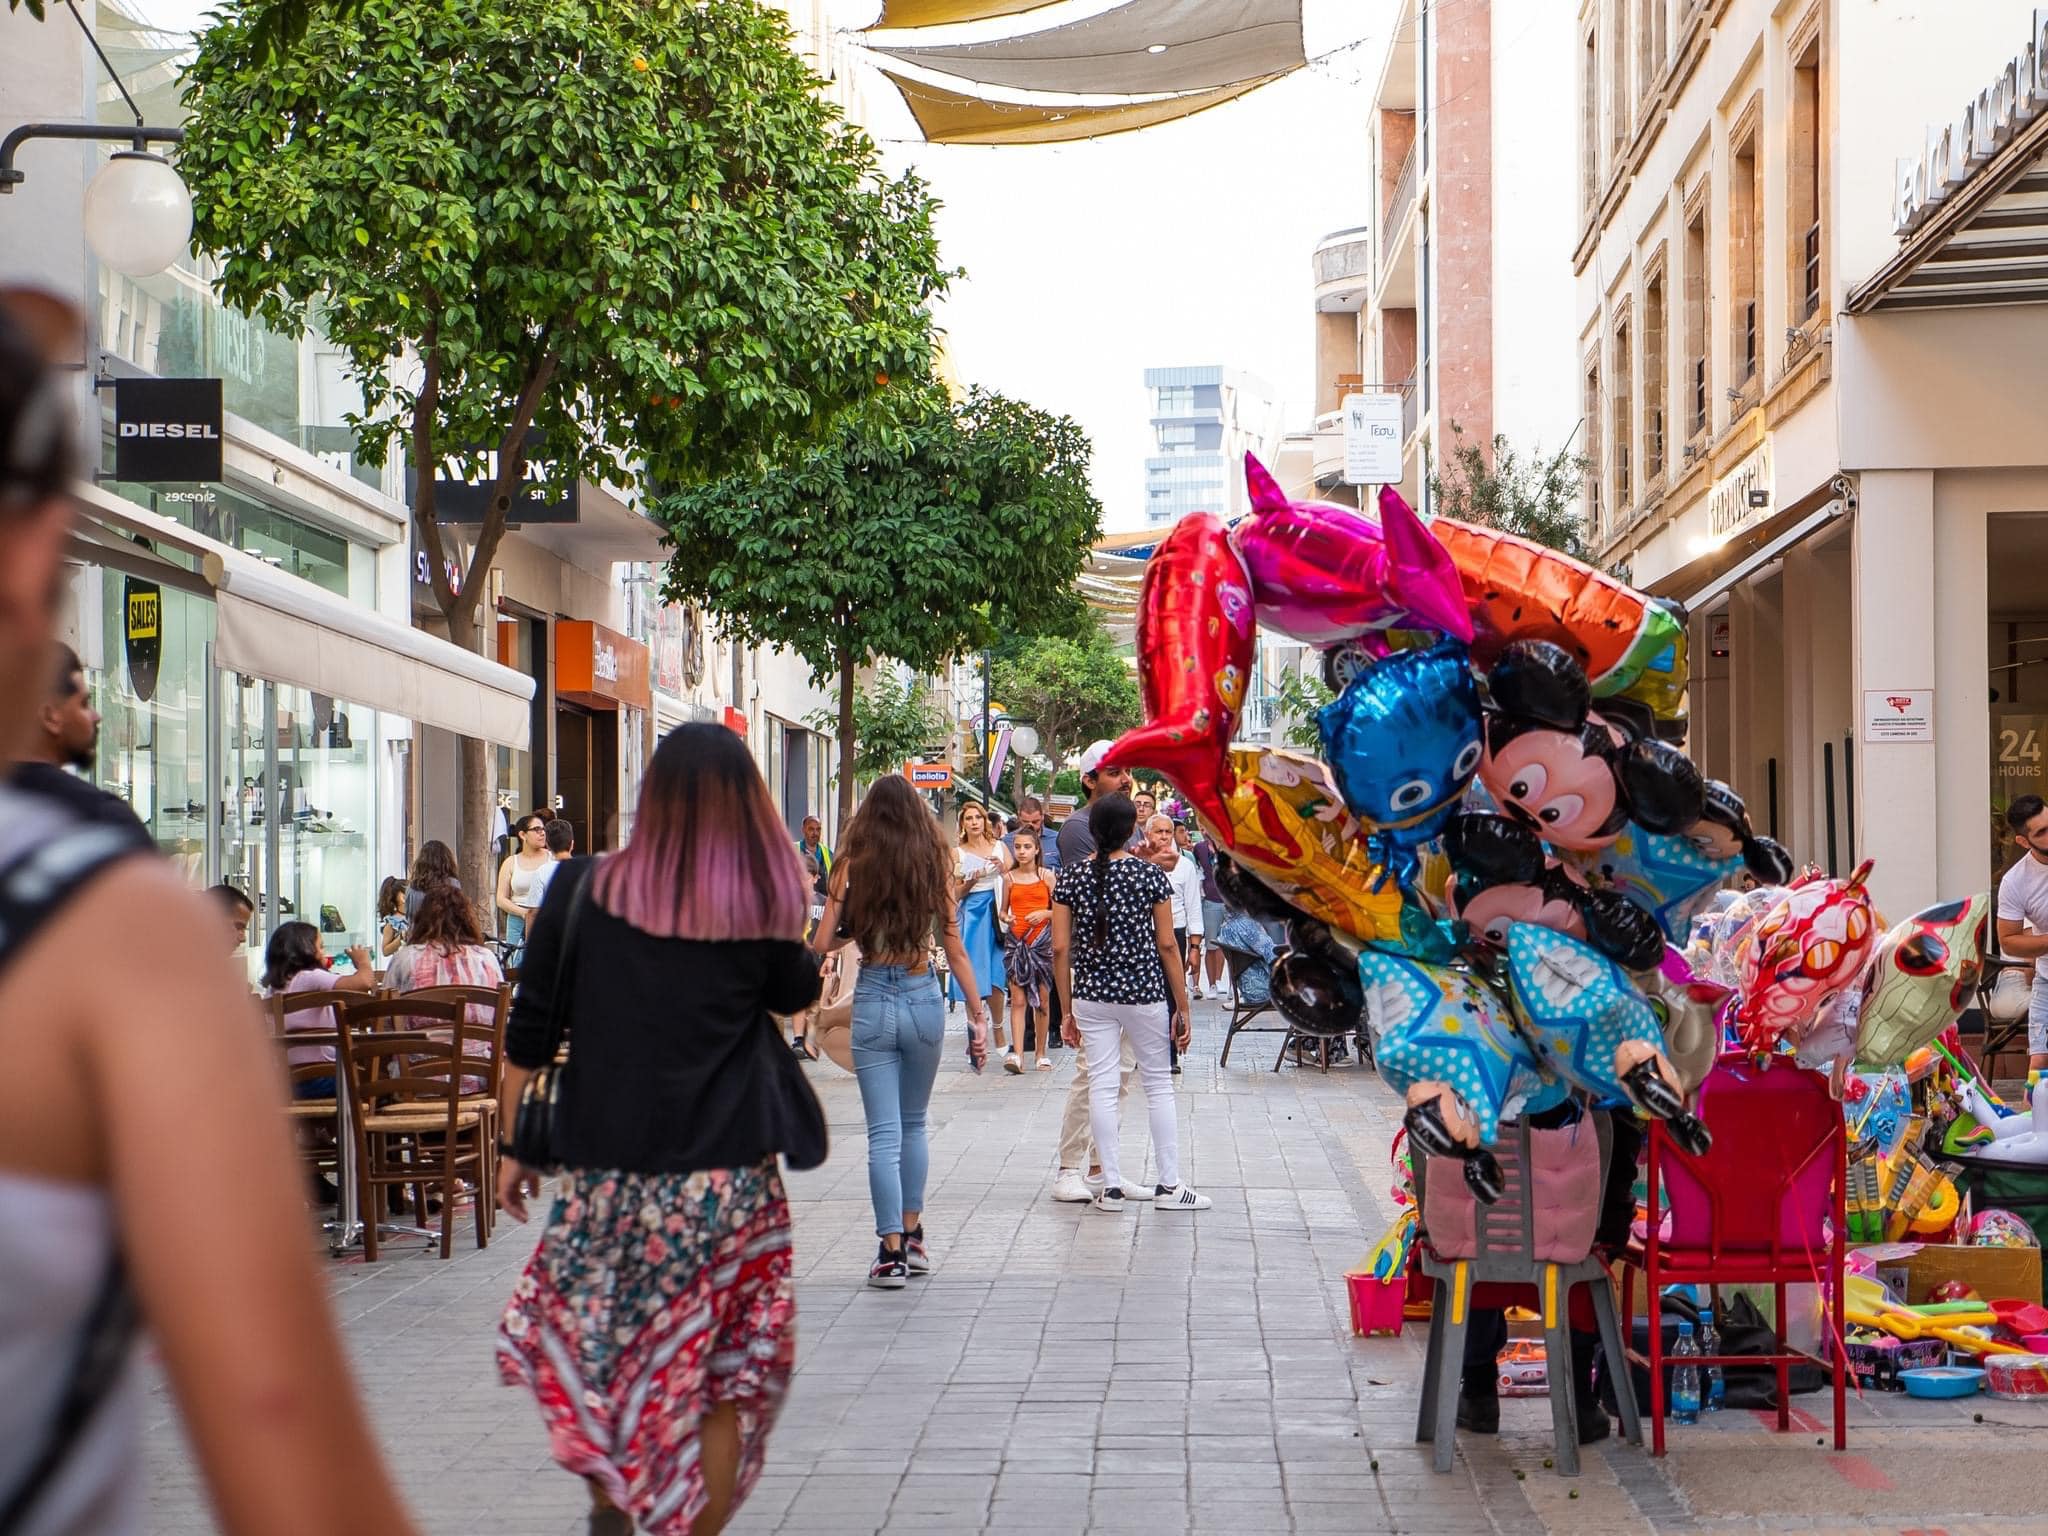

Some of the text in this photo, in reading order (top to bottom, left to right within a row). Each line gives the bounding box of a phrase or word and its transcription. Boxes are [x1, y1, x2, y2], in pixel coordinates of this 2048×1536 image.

[214, 305, 252, 384] DIESEL
[120, 423, 219, 439] DIESEL
[530, 489, 569, 501] shs
[130, 599, 157, 631] SALES
[1999, 729, 2042, 762] 24
[1999, 765, 2042, 777] HOURS
